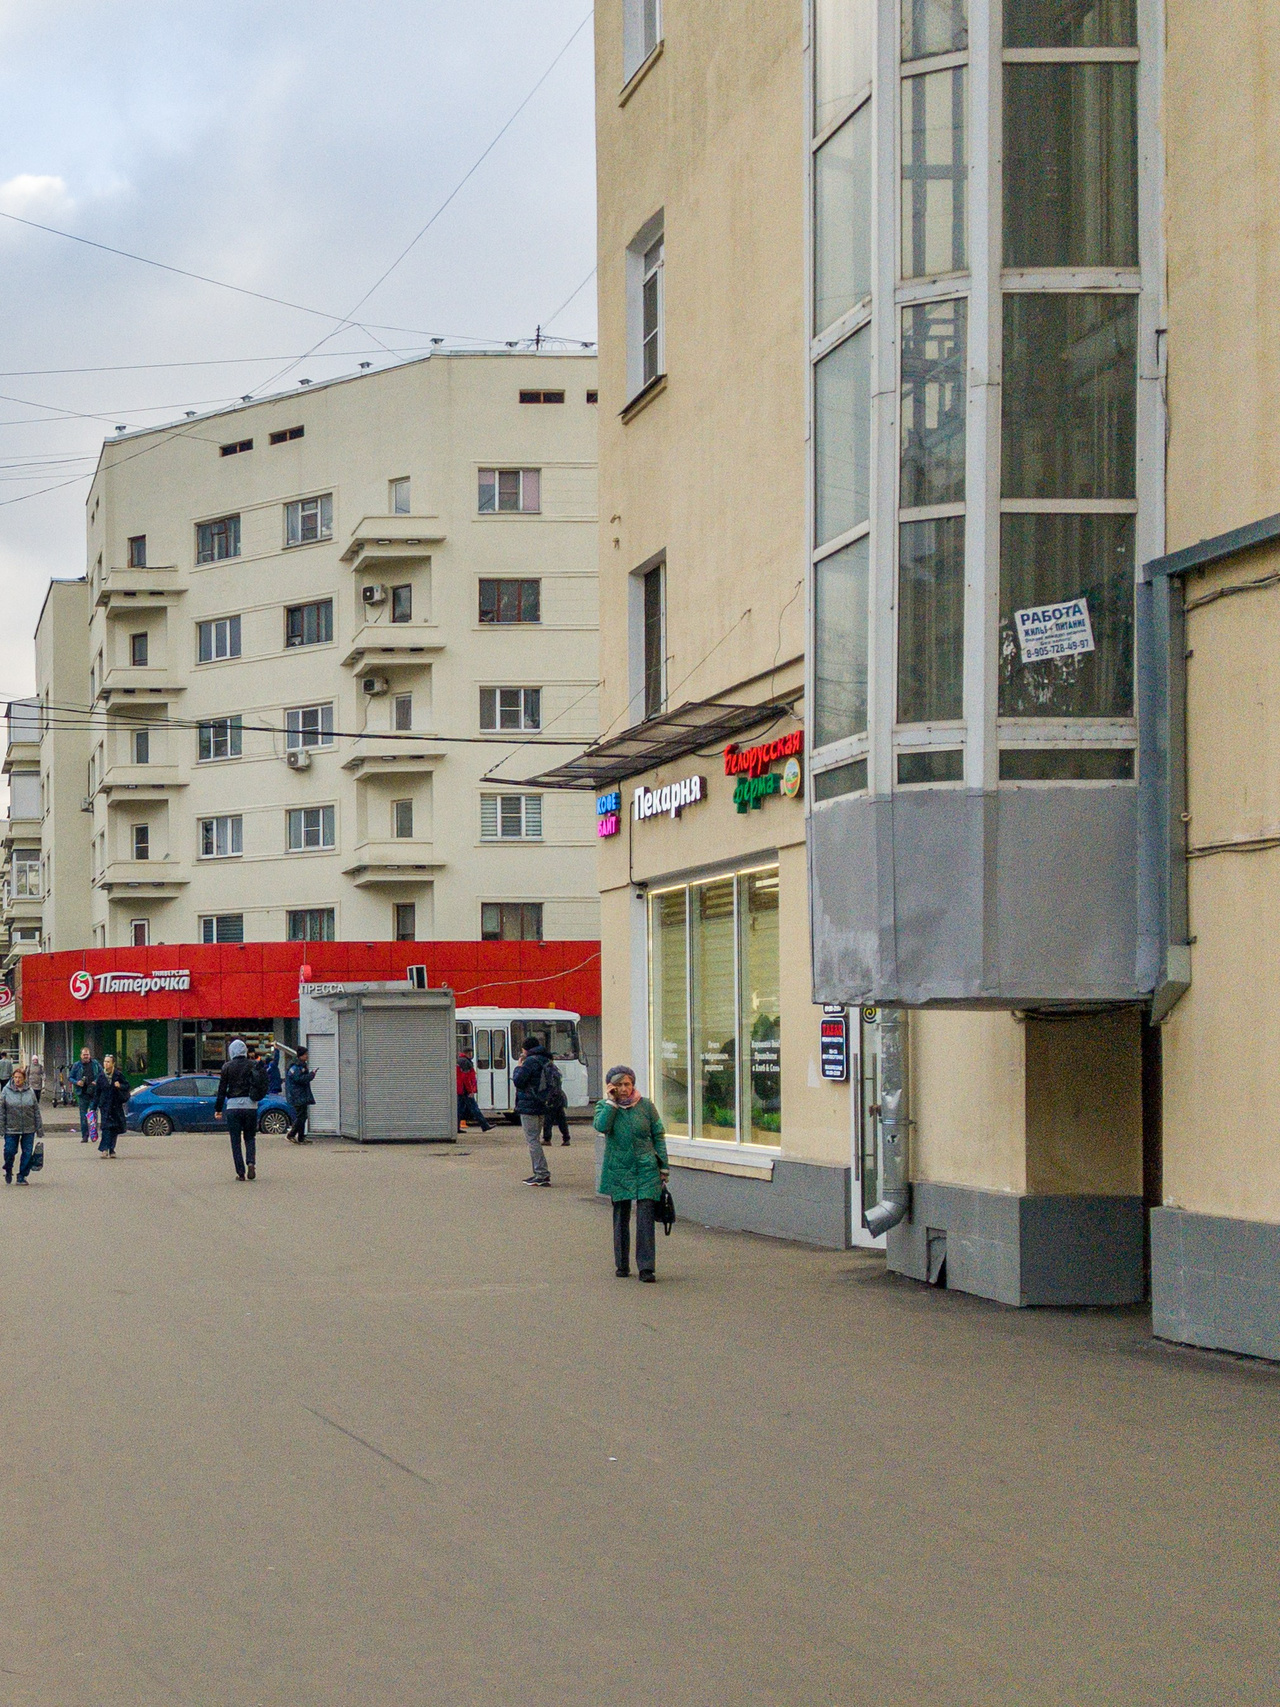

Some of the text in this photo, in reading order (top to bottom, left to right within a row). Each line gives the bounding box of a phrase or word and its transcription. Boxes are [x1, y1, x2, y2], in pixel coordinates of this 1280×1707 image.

[1020, 603, 1083, 626] РАБОТА
[1055, 618, 1086, 632] ПИТАНИЕ
[724, 730, 801, 778] Белорусская
[596, 792, 617, 815] КОФЕ
[634, 775, 701, 820] Пекарня
[733, 773, 775, 811] ферма
[597, 812, 617, 838] БАЙТ
[94, 971, 191, 997] Пятерочка
[300, 983, 345, 995] ПРЕССА
[822, 1024, 844, 1036] ТАБАК
